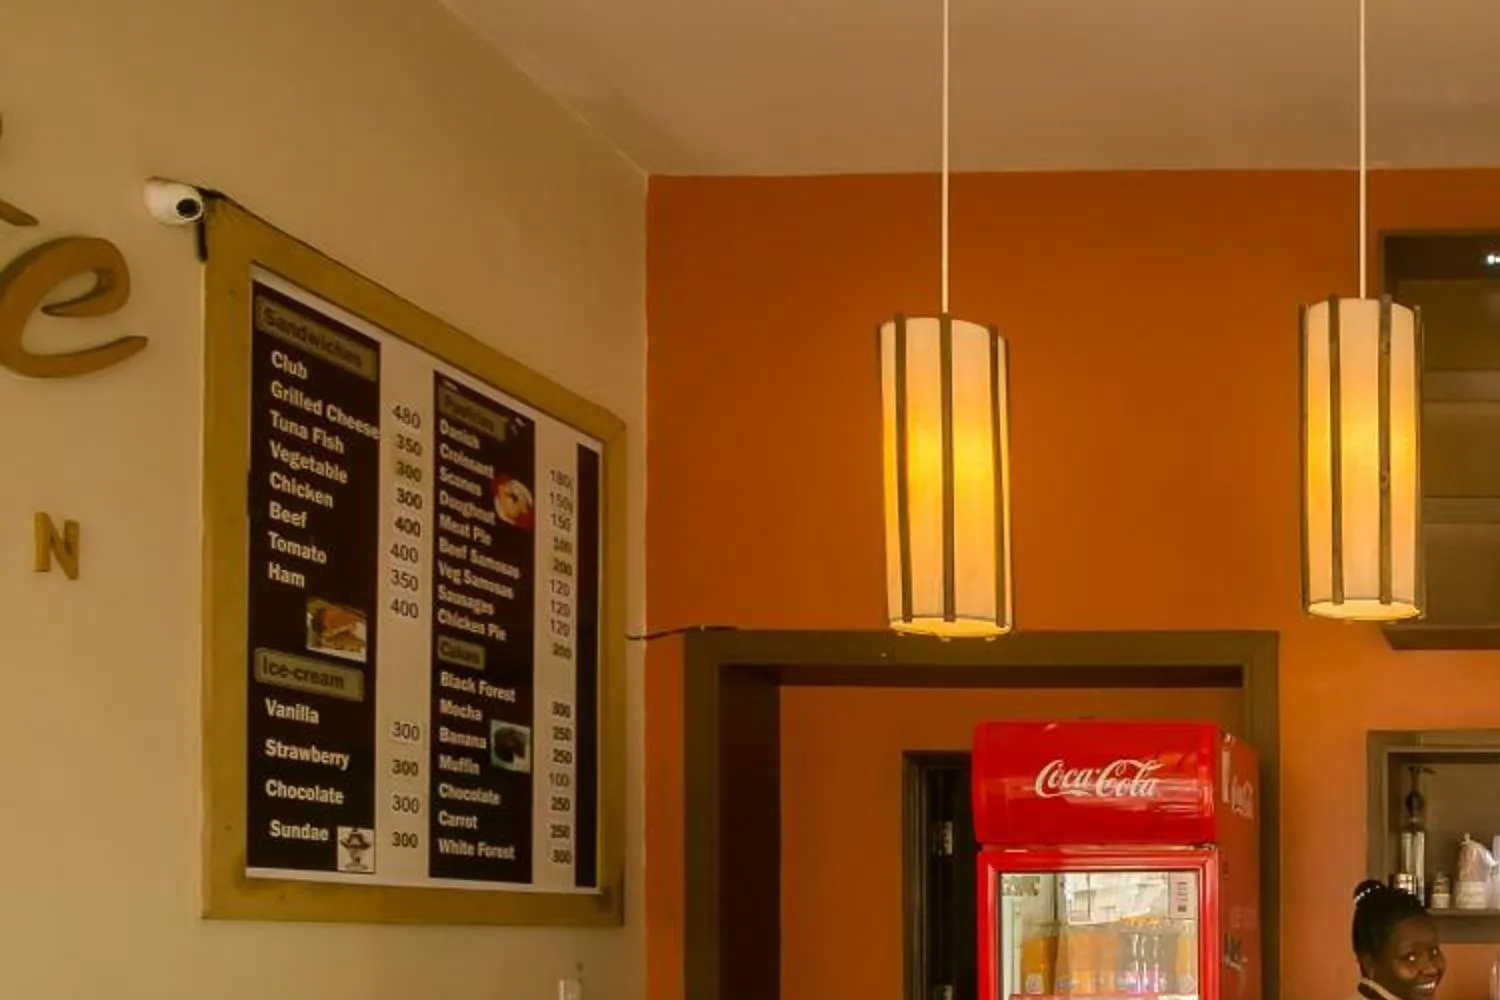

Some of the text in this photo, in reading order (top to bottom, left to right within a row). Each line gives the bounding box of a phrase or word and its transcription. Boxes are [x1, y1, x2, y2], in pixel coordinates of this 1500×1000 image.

[271, 351, 308, 380] Club
[392, 404, 421, 429] 480
[271, 380, 423, 456] Grilled Cheese 350
[269, 409, 422, 482] Tuna Fish 300
[269, 439, 423, 510] Vegetable 300
[269, 471, 421, 538] Chicken 400
[34, 511, 80, 580] N
[268, 501, 419, 563] Beef 400
[268, 531, 419, 592] Tomato 350
[268, 561, 419, 619] Ham 400
[263, 656, 344, 689] Ice-cream
[440, 671, 476, 694] Black
[478, 680, 516, 703] Forest
[265, 697, 420, 741] Vanilla 300
[439, 698, 483, 722] Mocha
[439, 726, 487, 749] Banana
[265, 739, 419, 777] Strawberry 300
[439, 753, 480, 776] Muffin
[265, 779, 420, 814] Chocolate 300
[438, 783, 501, 806] Chocolate
[1035, 759, 1165, 799] Coca-Cola
[269, 819, 418, 849] Sundae 300
[438, 810, 478, 830] Carrot
[438, 838, 474, 857] White
[477, 841, 516, 861] Forest
